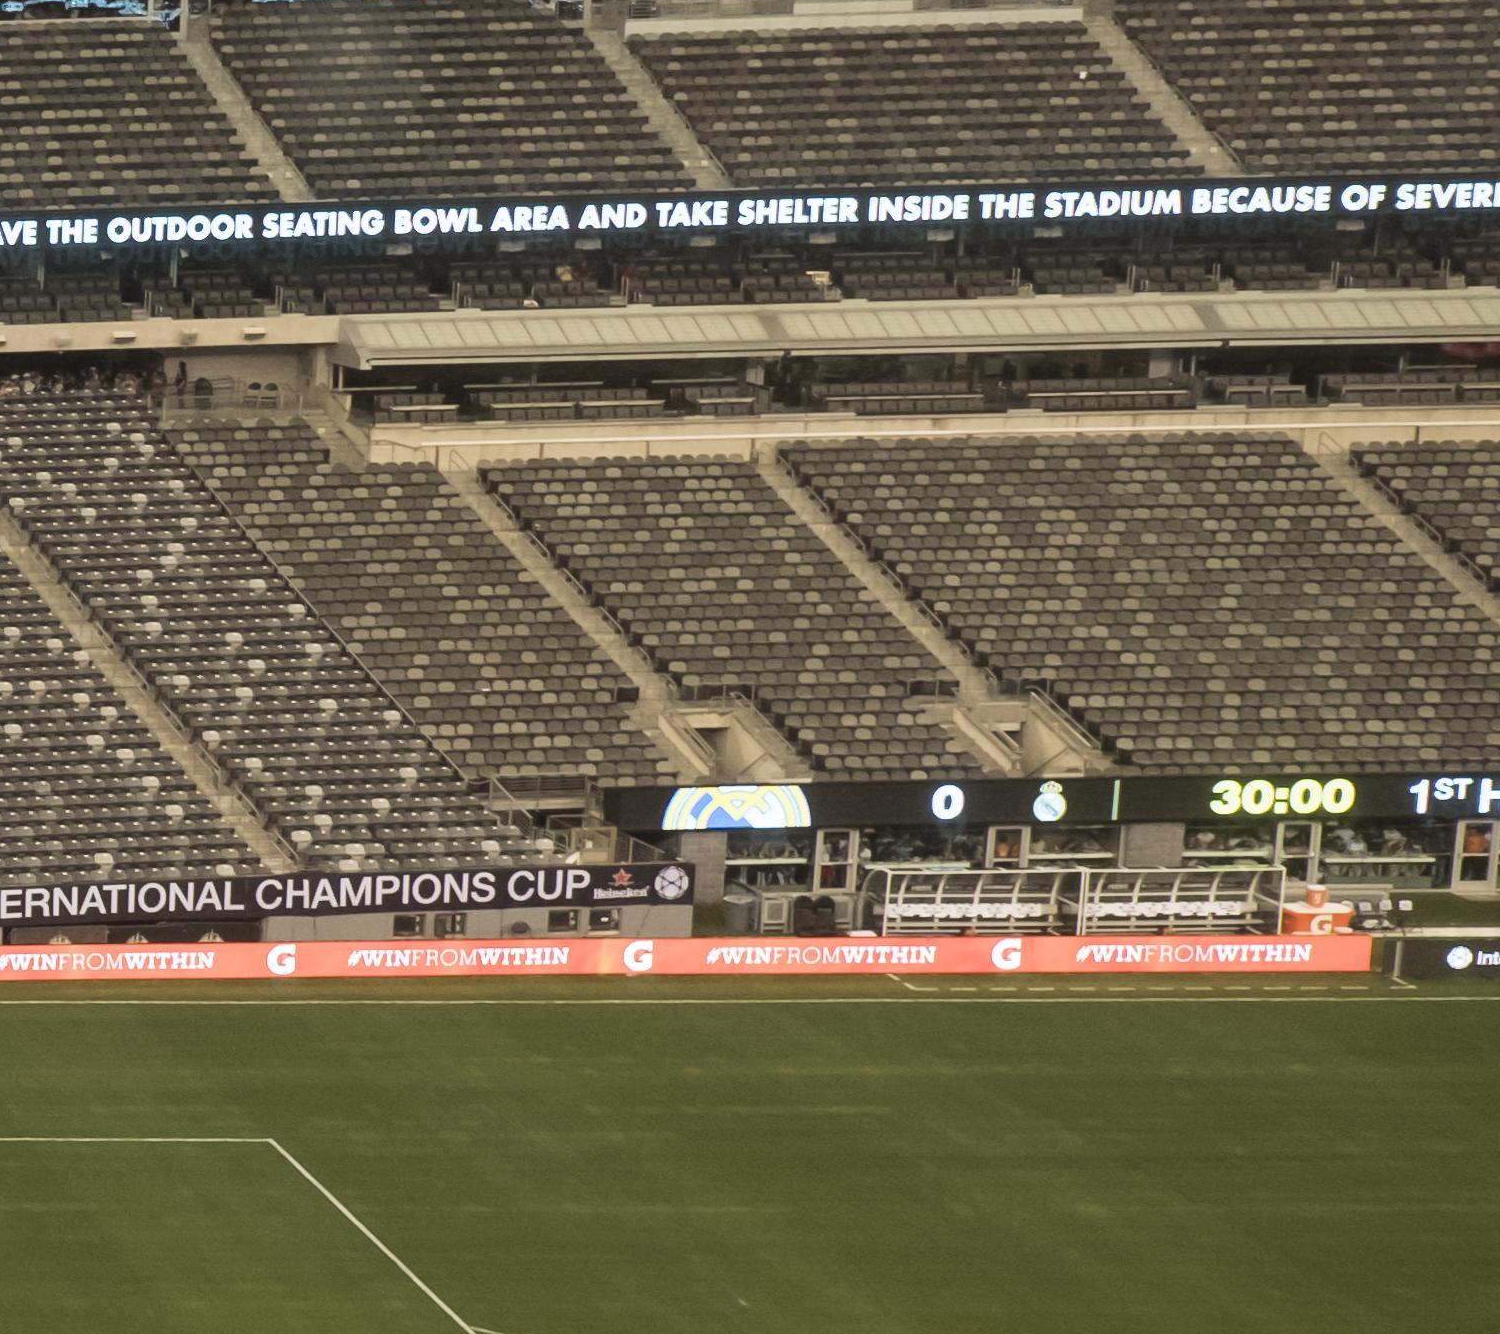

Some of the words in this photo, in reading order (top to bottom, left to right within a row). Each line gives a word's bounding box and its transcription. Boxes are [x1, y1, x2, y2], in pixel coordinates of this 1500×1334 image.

[46, 219, 98, 244] THE
[107, 214, 253, 243] OUTDOOR
[262, 210, 384, 238] SEATING
[394, 208, 482, 234] BOWL
[490, 205, 569, 231] AREA
[578, 203, 647, 229] AND
[656, 201, 728, 227] TAKE
[738, 198, 858, 225] SHELTER
[869, 195, 969, 221] INSIDE
[979, 193, 1035, 219] THE
[1044, 190, 1181, 218] STADIUM
[1192, 186, 1331, 213] BECAUSE
[1341, 185, 1386, 211] OF
[932, 785, 964, 819] 0
[1210, 779, 1355, 814] 30:00
[1410, 778, 1473, 814] 1ST
[256, 872, 495, 909] CHAMPIONS
[508, 869, 591, 901] CUP
